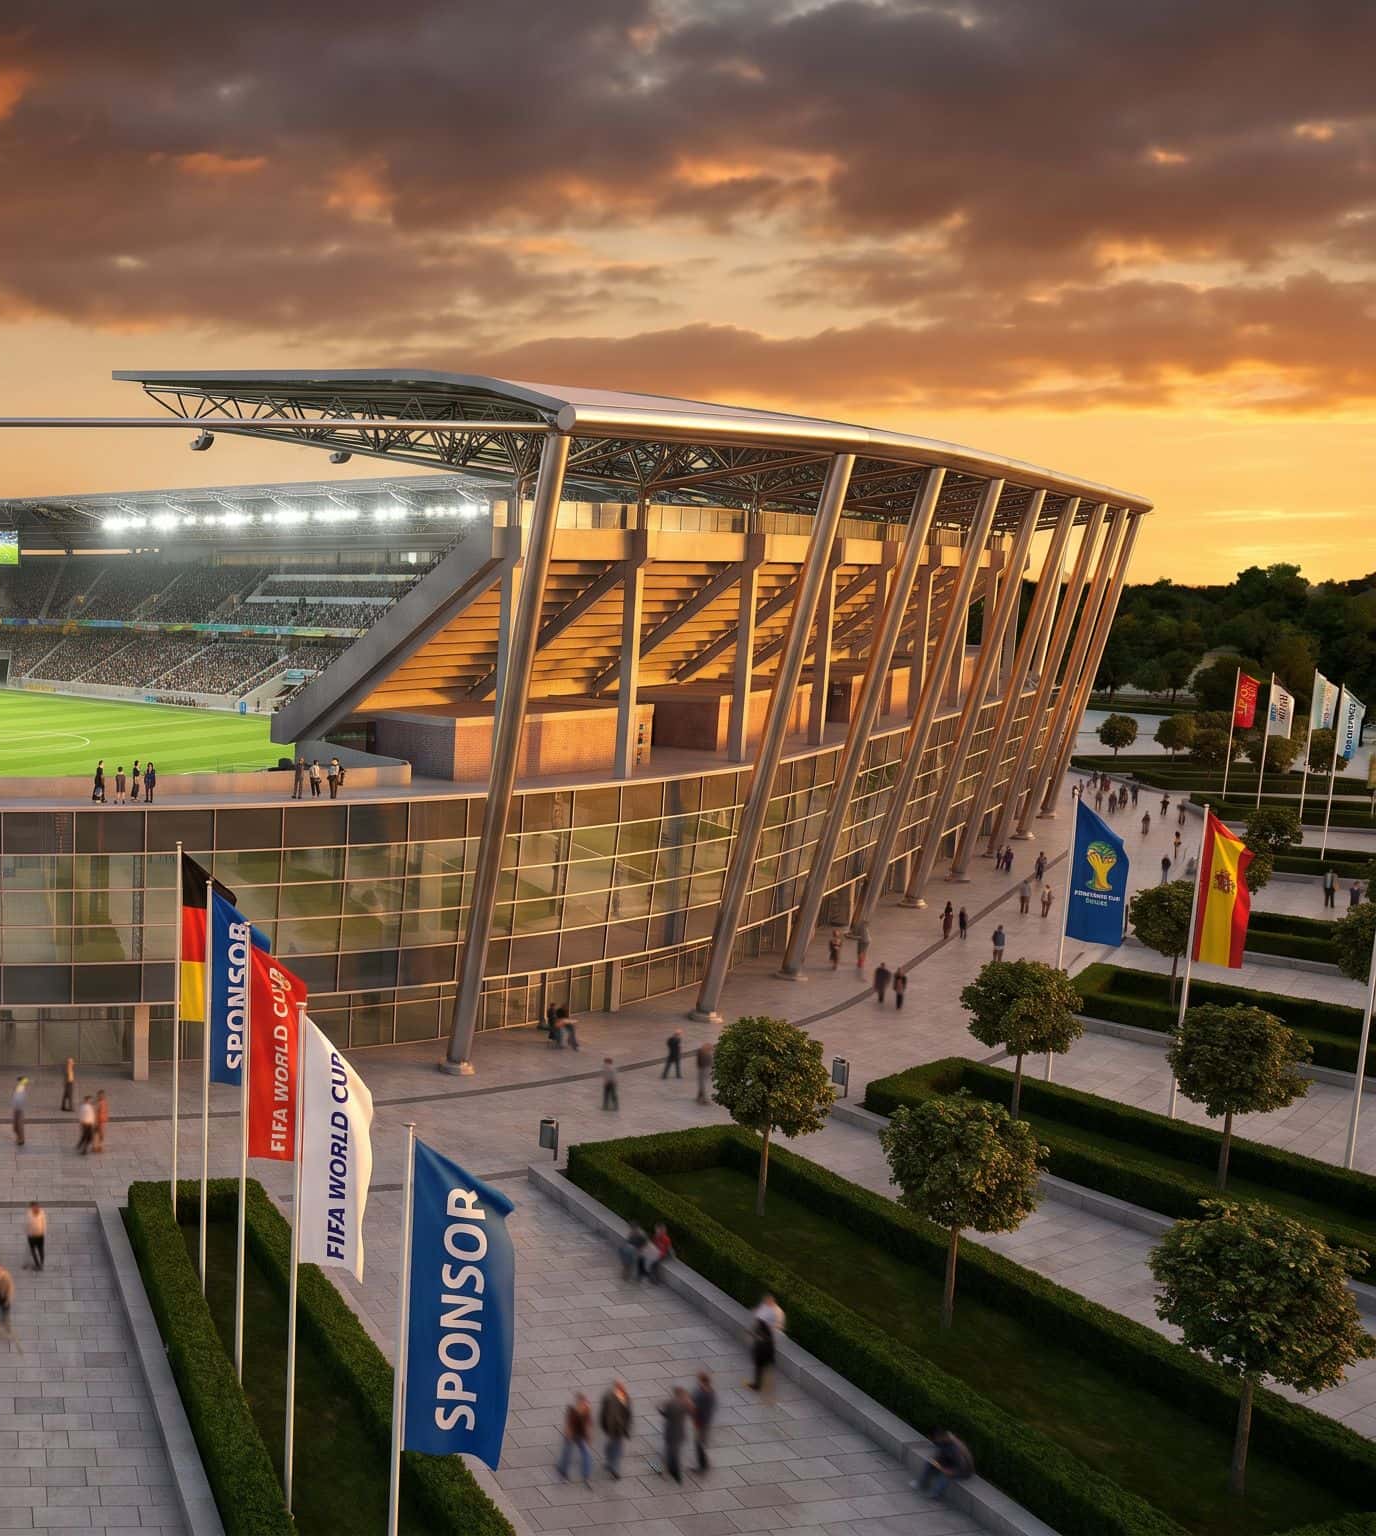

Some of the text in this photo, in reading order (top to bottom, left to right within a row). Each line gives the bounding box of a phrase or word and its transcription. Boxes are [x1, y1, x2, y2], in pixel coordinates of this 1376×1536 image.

[271, 1109, 288, 1152] FIFA
[273, 1027, 289, 1102] WORLD
[327, 1052, 349, 1260] FIFA WORLD CUP
[435, 1187, 488, 1431] SPONSOR
